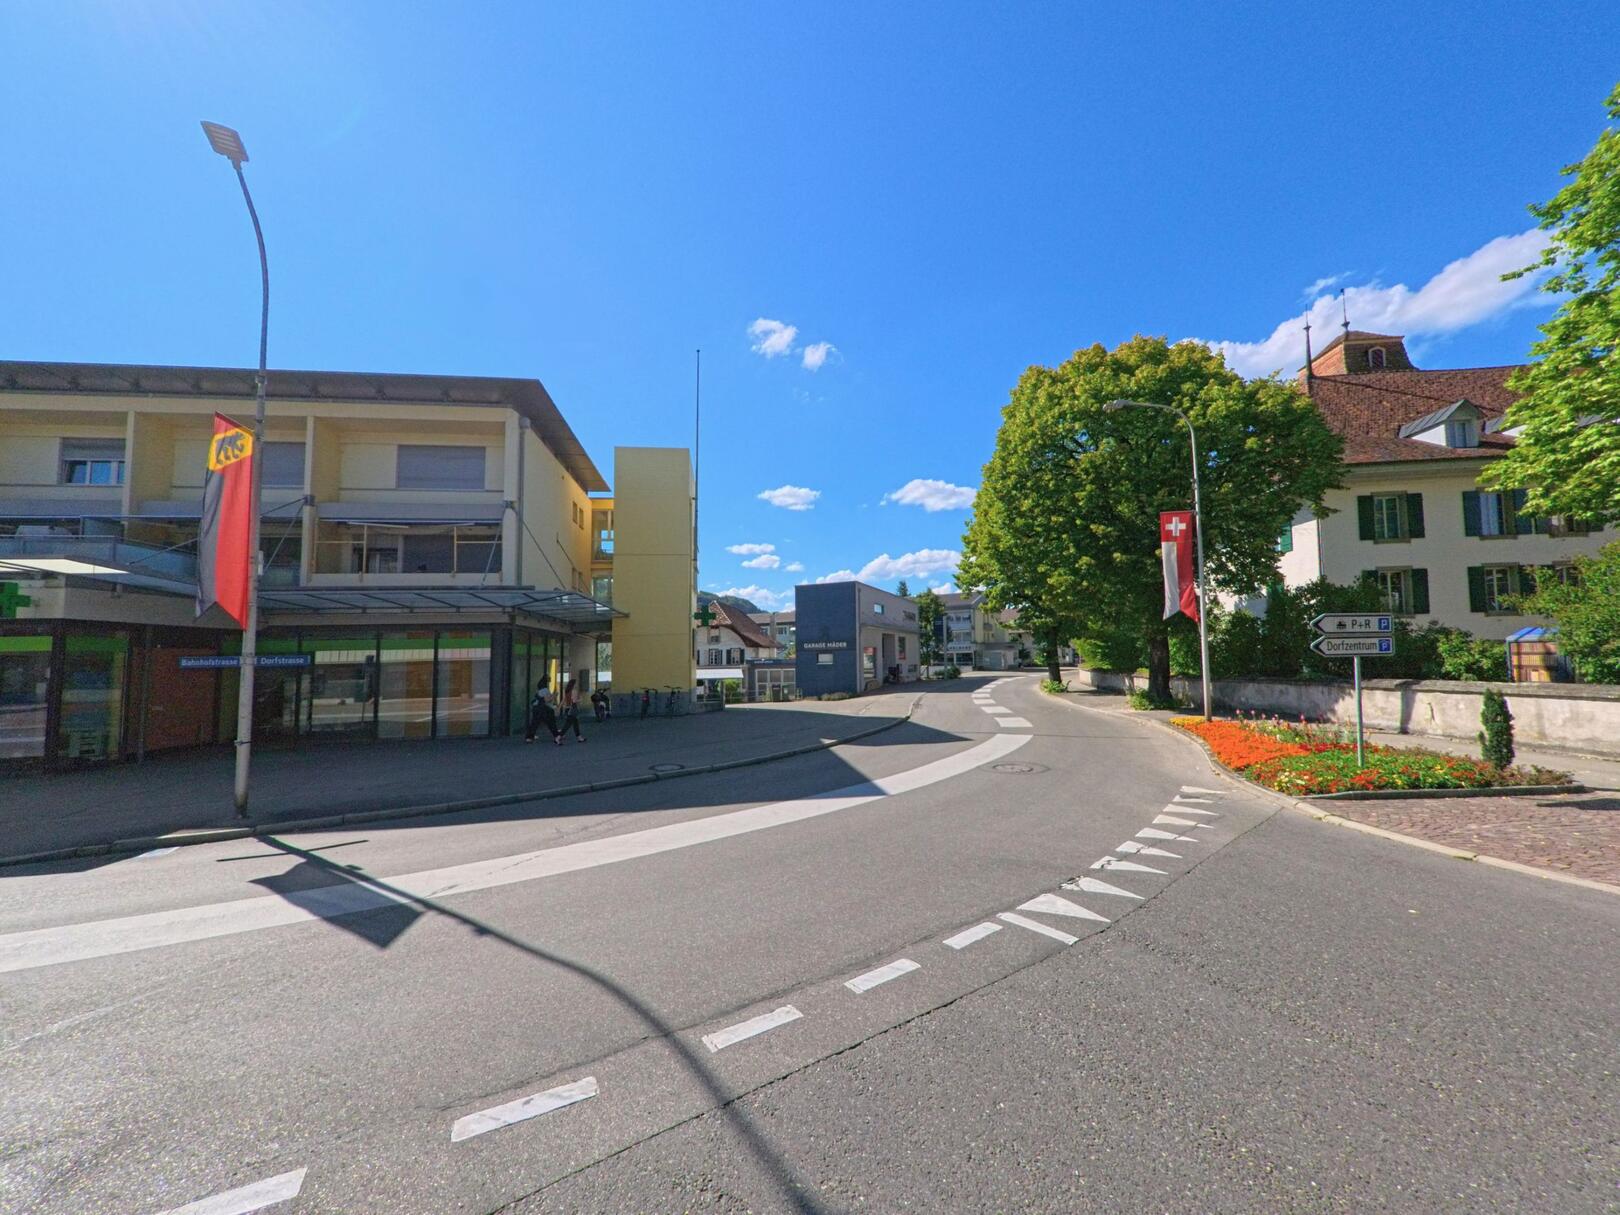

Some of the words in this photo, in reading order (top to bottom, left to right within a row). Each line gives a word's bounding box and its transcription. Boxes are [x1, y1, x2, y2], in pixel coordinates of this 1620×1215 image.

[1351, 619, 1371, 629] P+R
[1327, 640, 1377, 651] Dorfzentrum
[181, 658, 238, 667] Bahnhofstrasse
[260, 656, 305, 665] Dorfstrasse
